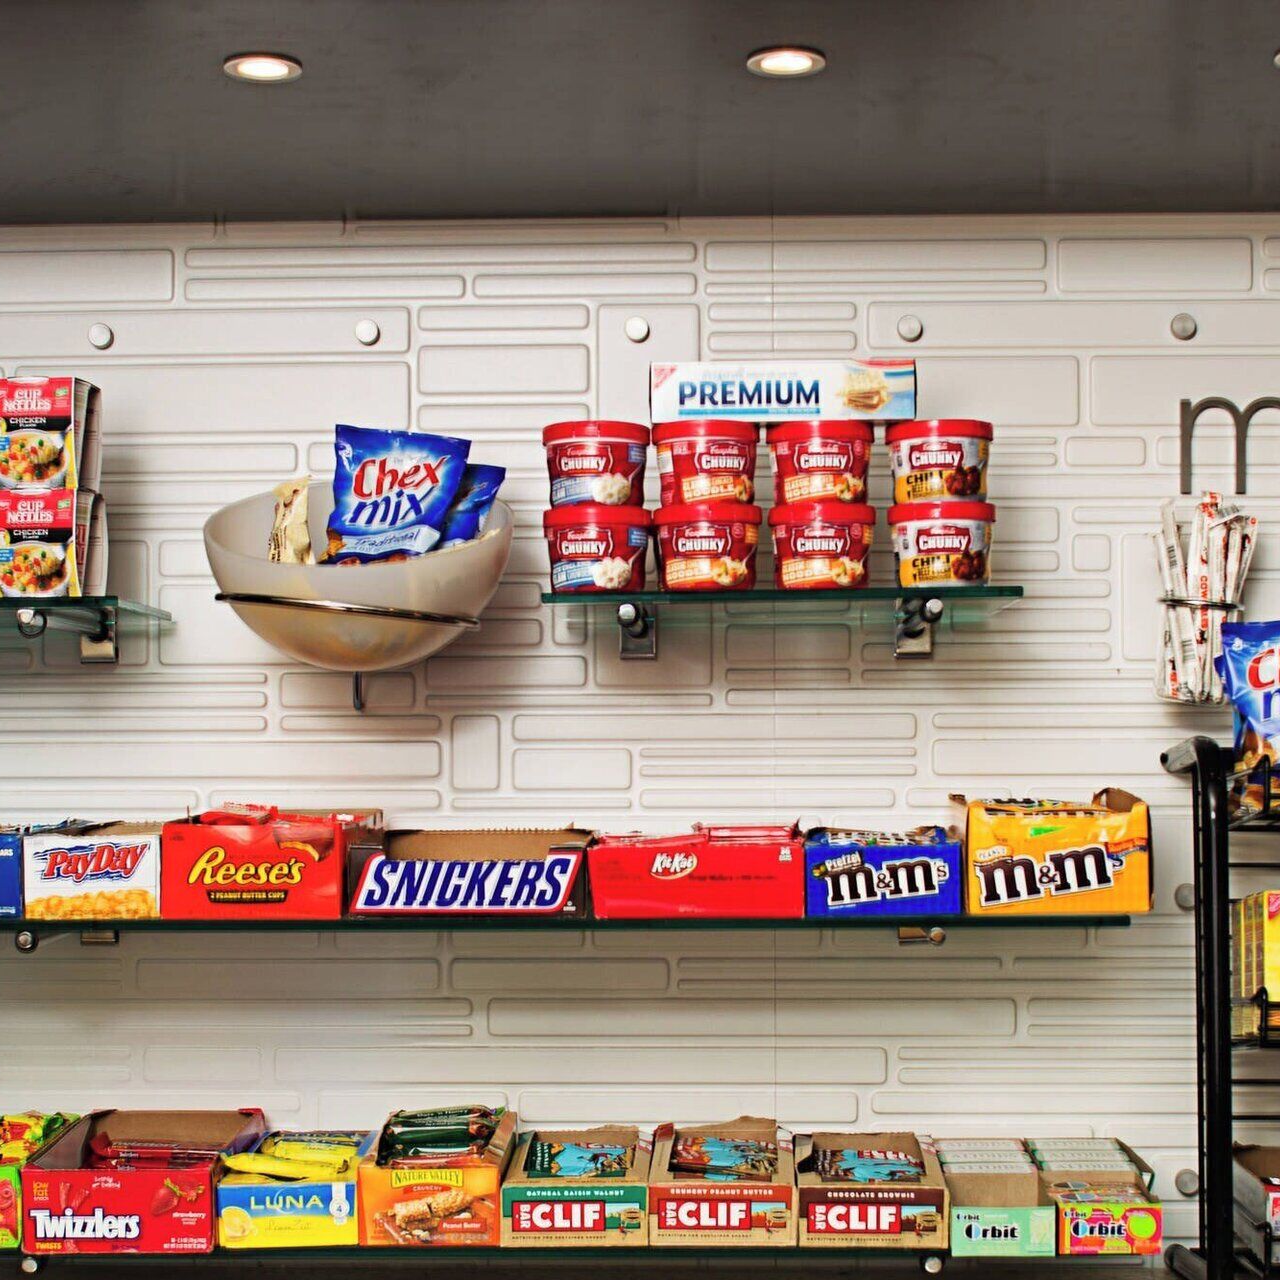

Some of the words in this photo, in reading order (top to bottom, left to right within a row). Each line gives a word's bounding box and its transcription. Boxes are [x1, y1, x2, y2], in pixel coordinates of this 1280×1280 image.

[678, 379, 820, 406] PREMIUM
[3, 399, 52, 413] NOODLES
[560, 456, 607, 472] CHUNKY
[701, 454, 746, 471] CHUNKY
[799, 454, 848, 469] CHUNKY
[910, 451, 962, 468] CHUNKY
[352, 455, 451, 500] Chex
[345, 487, 436, 527] mix
[561, 540, 607, 555] CHUNKY
[918, 534, 970, 550] CHUNKY
[41, 842, 150, 882] PayDay
[187, 846, 306, 886] Reese's
[824, 851, 862, 872] Pretzel
[363, 857, 573, 908] SNICKERS
[215, 891, 241, 900] PEANUT
[241, 891, 267, 900] BUTTER
[267, 891, 286, 900] CUPS
[394, 1170, 428, 1185] NATURE
[429, 1170, 461, 1184] VALLEY
[526, 1189, 561, 1197] OATMEAL
[563, 1189, 591, 1197] RAISIN
[593, 1189, 625, 1197] WALNUT
[826, 1190, 876, 1199] CHOCOLATE
[877, 1191, 916, 1199] BROWNIE
[249, 1194, 325, 1211] LUNA
[519, 1203, 531, 1229] BAR
[531, 1202, 601, 1229] CLIF
[665, 1201, 677, 1227] BAR
[677, 1201, 747, 1227] CLIF
[814, 1204, 827, 1231] BAR
[826, 1204, 898, 1231] CLIF
[29, 1207, 140, 1240] Twizzlers
[442, 1221, 463, 1230] Peanut
[463, 1221, 482, 1230] Butter
[964, 1222, 1020, 1240] Orbit
[1071, 1219, 1128, 1238] Orbit
[35, 1241, 63, 1250] TWISTS
